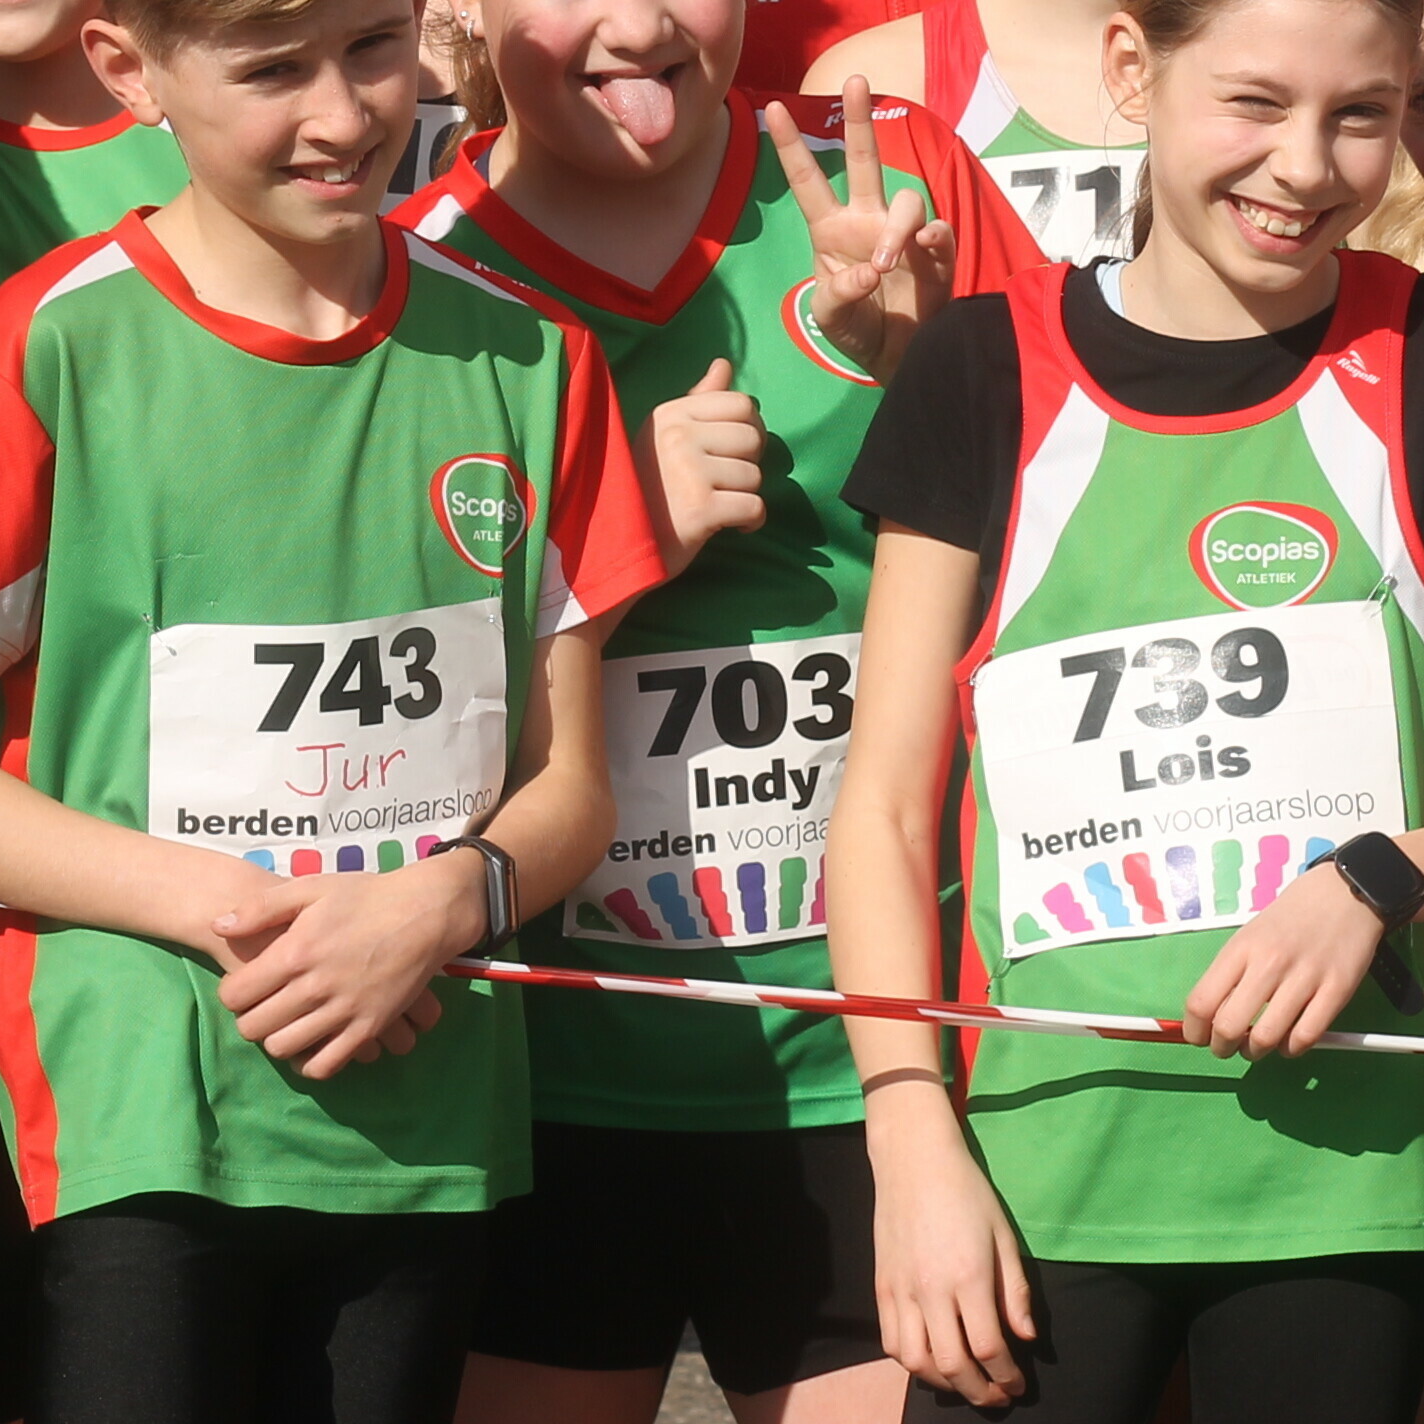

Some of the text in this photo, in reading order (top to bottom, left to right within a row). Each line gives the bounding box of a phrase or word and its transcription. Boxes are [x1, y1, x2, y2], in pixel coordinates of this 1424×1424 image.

[1211, 537, 1320, 568] Scopias
[1236, 571, 1297, 586] ATLETIEK
[254, 627, 443, 733] 743
[637, 652, 855, 758] 703
[1060, 627, 1290, 744] 739
[285, 743, 406, 796] Jur
[694, 758, 821, 810] Indy
[1119, 734, 1252, 793] Lois
[177, 787, 493, 836] berden voorjaarsloop
[1021, 787, 1376, 860] berden voorjaarsloop
